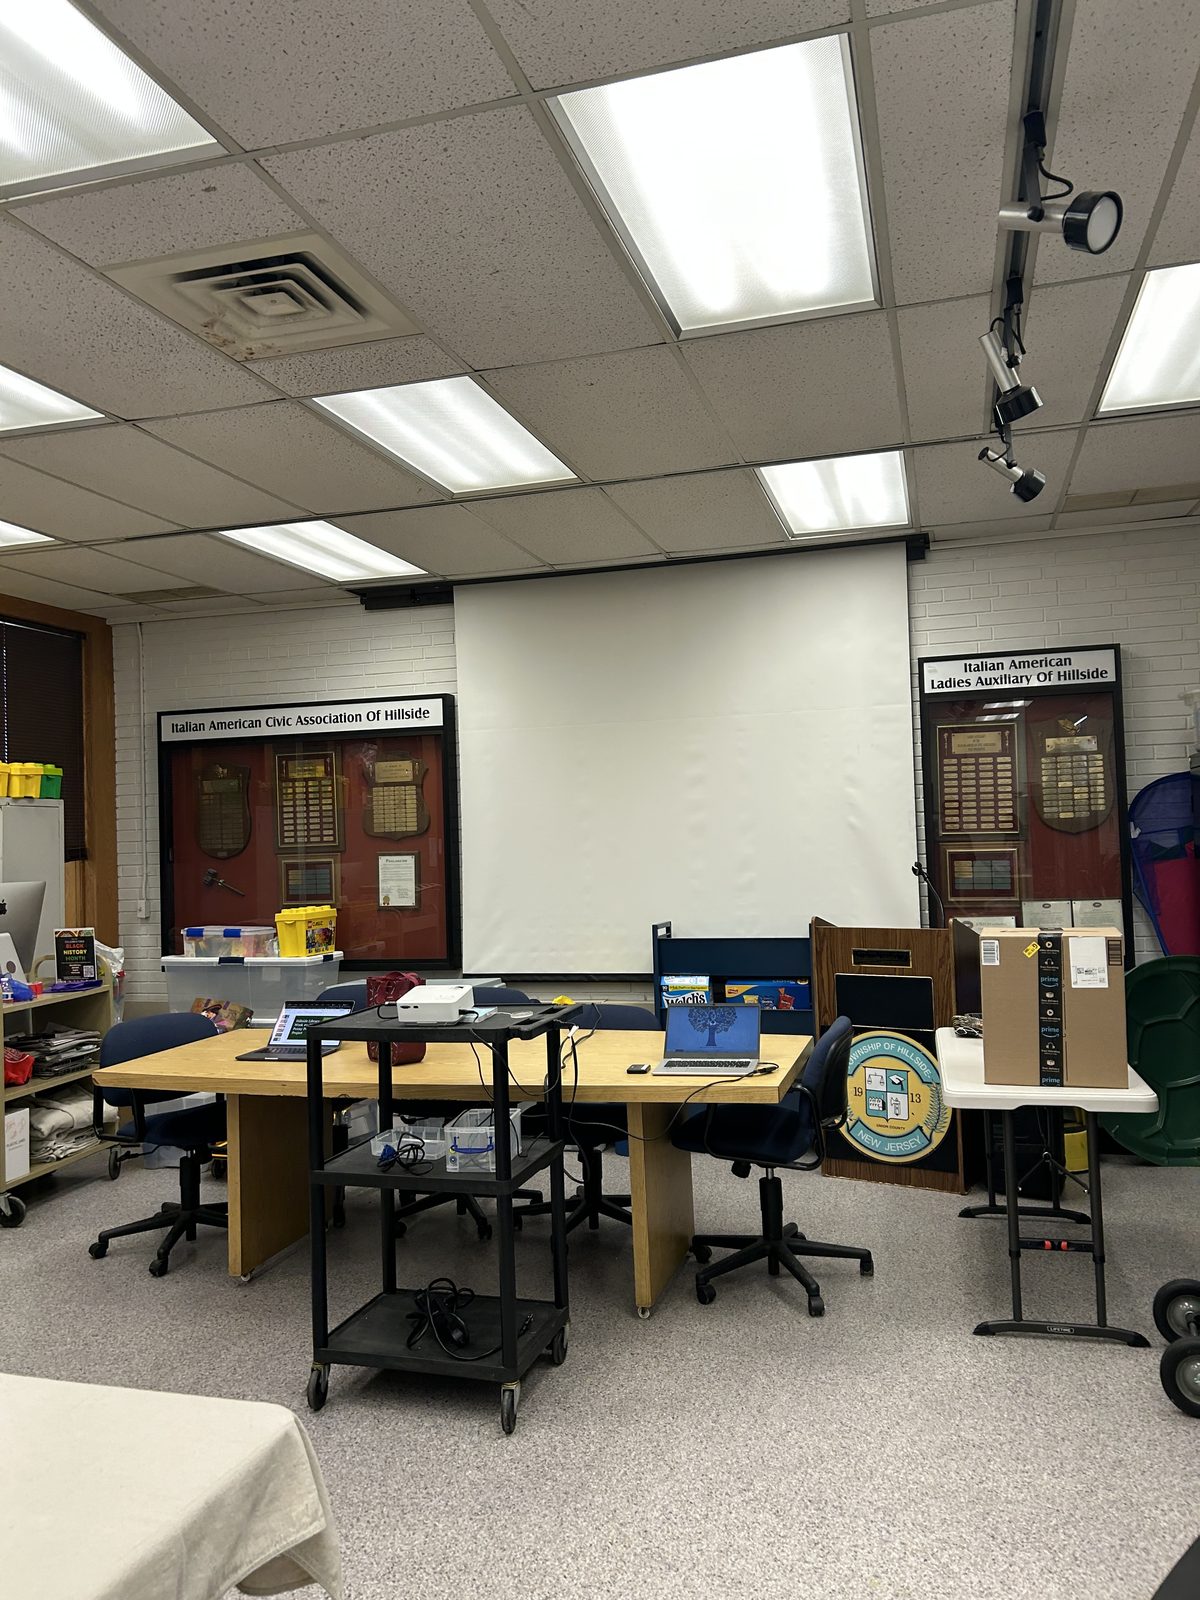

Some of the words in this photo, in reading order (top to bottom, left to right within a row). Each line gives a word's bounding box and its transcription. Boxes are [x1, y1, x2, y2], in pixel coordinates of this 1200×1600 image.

[964, 661, 1004, 673] Italian
[1009, 657, 1072, 670] American
[931, 677, 971, 689] Ladies
[975, 673, 1032, 686] Auxiliary
[1037, 671, 1053, 682] Of
[1057, 668, 1108, 681] Hillside
[171, 721, 205, 733] Italian
[208, 718, 262, 731] American
[265, 715, 293, 727] Civic
[295, 712, 362, 726] Association
[366, 709, 381, 722] Of
[384, 707, 430, 721] Hillside
[848, 1043, 882, 1066] OWNSHIP
[883, 1042, 896, 1051] OF
[853, 1086, 863, 1097] 19
[910, 1093, 921, 1103] 13
[857, 1129, 882, 1149] NEW
[884, 1136, 921, 1152] JERSEY
